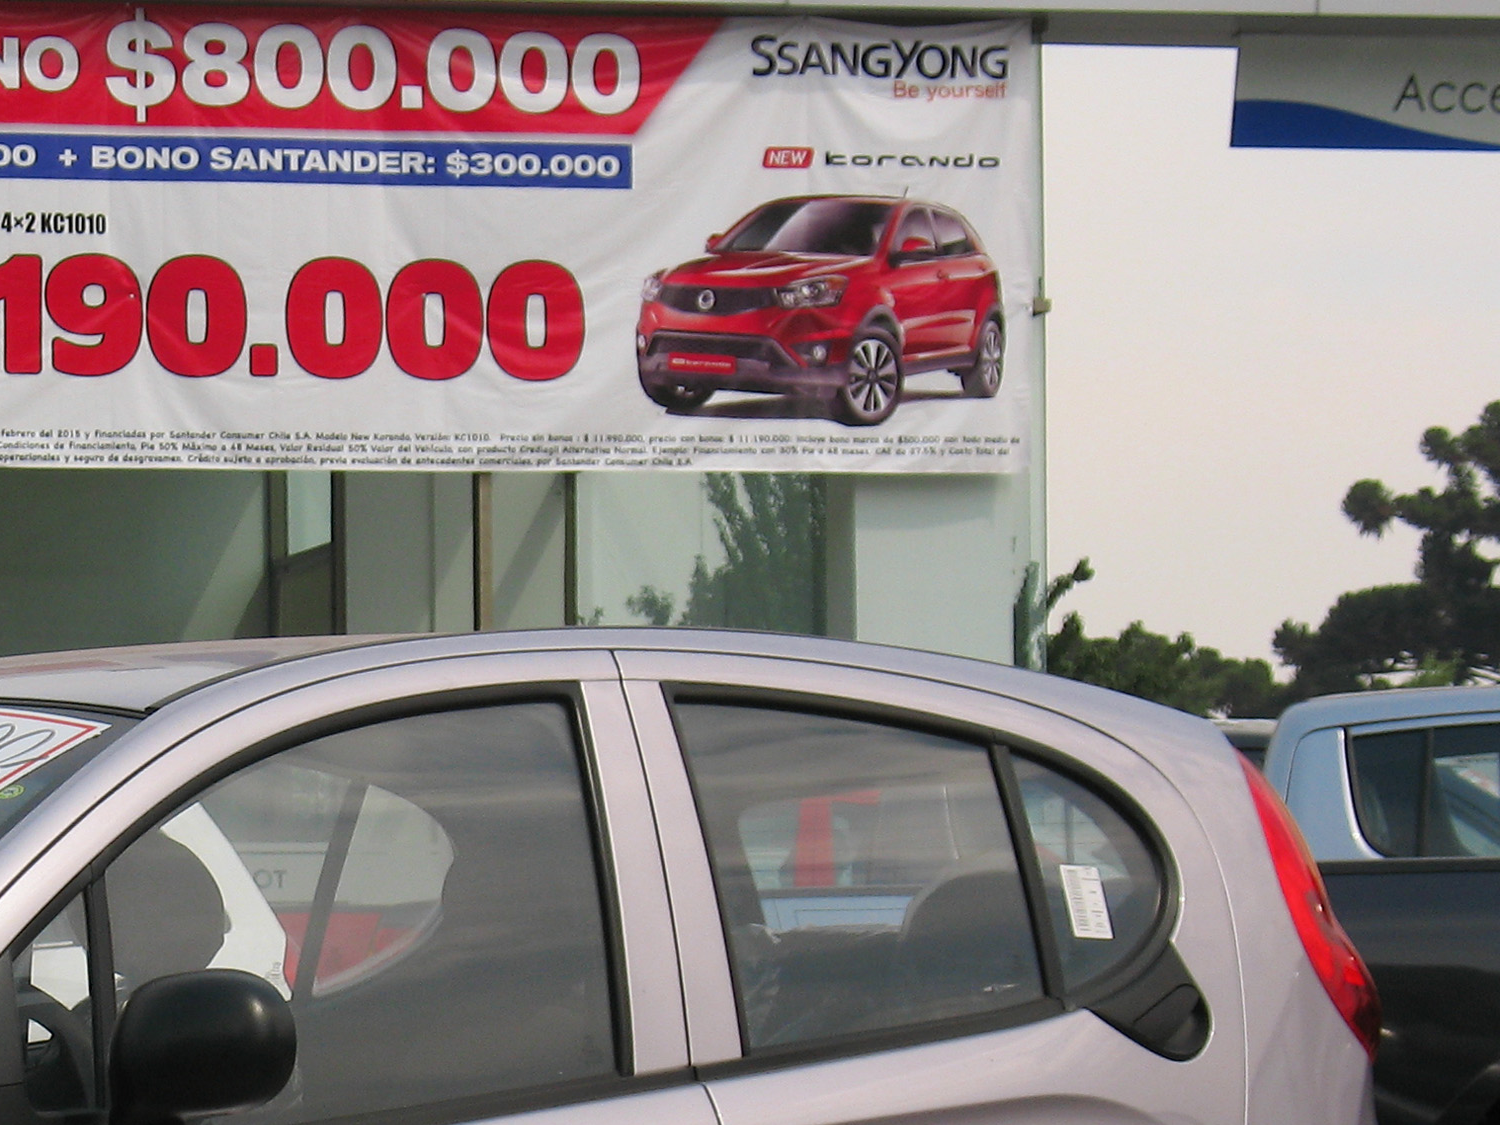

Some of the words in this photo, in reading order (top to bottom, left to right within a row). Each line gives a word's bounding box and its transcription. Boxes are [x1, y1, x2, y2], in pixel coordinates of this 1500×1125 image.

[105, 8, 642, 123] $800.000
[893, 81, 922, 99] Be
[927, 80, 1007, 102] yourself
[58, 148, 78, 167] +
[91, 145, 199, 170] BONO
[210, 147, 437, 175] SANTANDER:
[446, 149, 621, 180] $300.000
[768, 149, 809, 166] NEW
[40, 213, 107, 236] KC1010
[1, 429, 36, 438] febrero
[169, 430, 217, 439] Santander
[220, 431, 265, 440] Consumer
[269, 431, 291, 440] Chile
[315, 432, 348, 441] Modelo
[500, 433, 529, 442] Precio
[280, 443, 303, 452] Valor
[307, 443, 344, 452] Residual
[74, 455, 104, 464] seguro
[223, 454, 252, 465] sujeto
